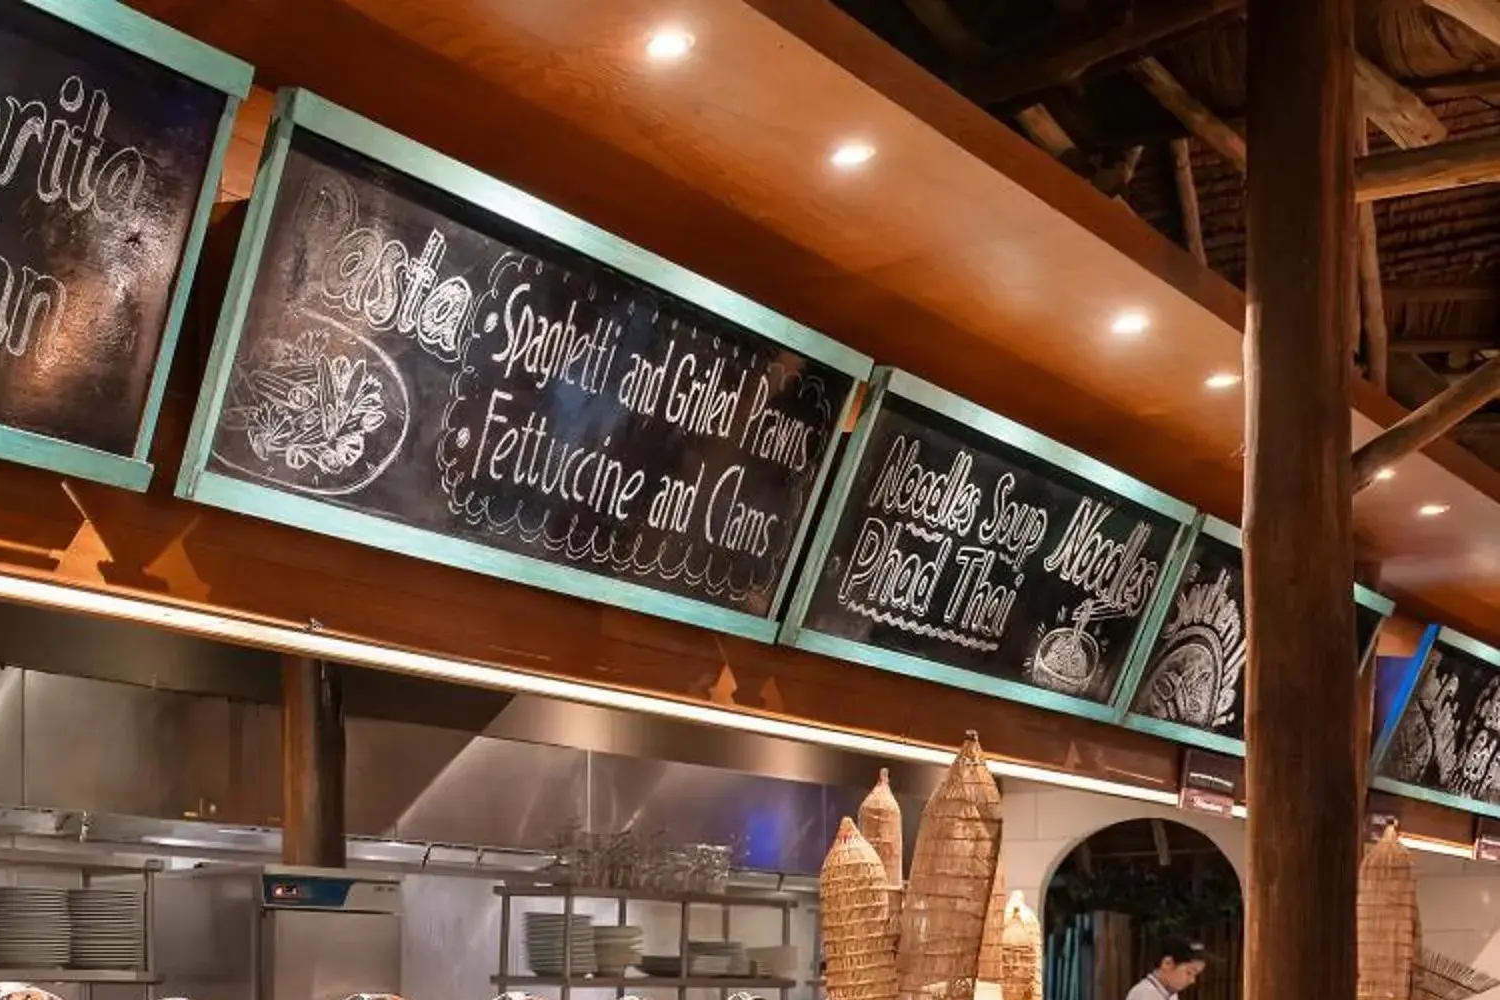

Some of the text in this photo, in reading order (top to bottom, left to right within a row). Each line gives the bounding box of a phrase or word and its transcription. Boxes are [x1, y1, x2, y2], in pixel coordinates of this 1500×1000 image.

[295, 170, 473, 362] Pasta
[491, 282, 814, 472] Spaghetti and Grilled Prawns
[471, 388, 779, 557] Fettuccine and Clams
[869, 435, 1048, 573] Noodles Soup
[838, 517, 1025, 637] Phad Thai
[1044, 496, 1159, 617] Noodles
